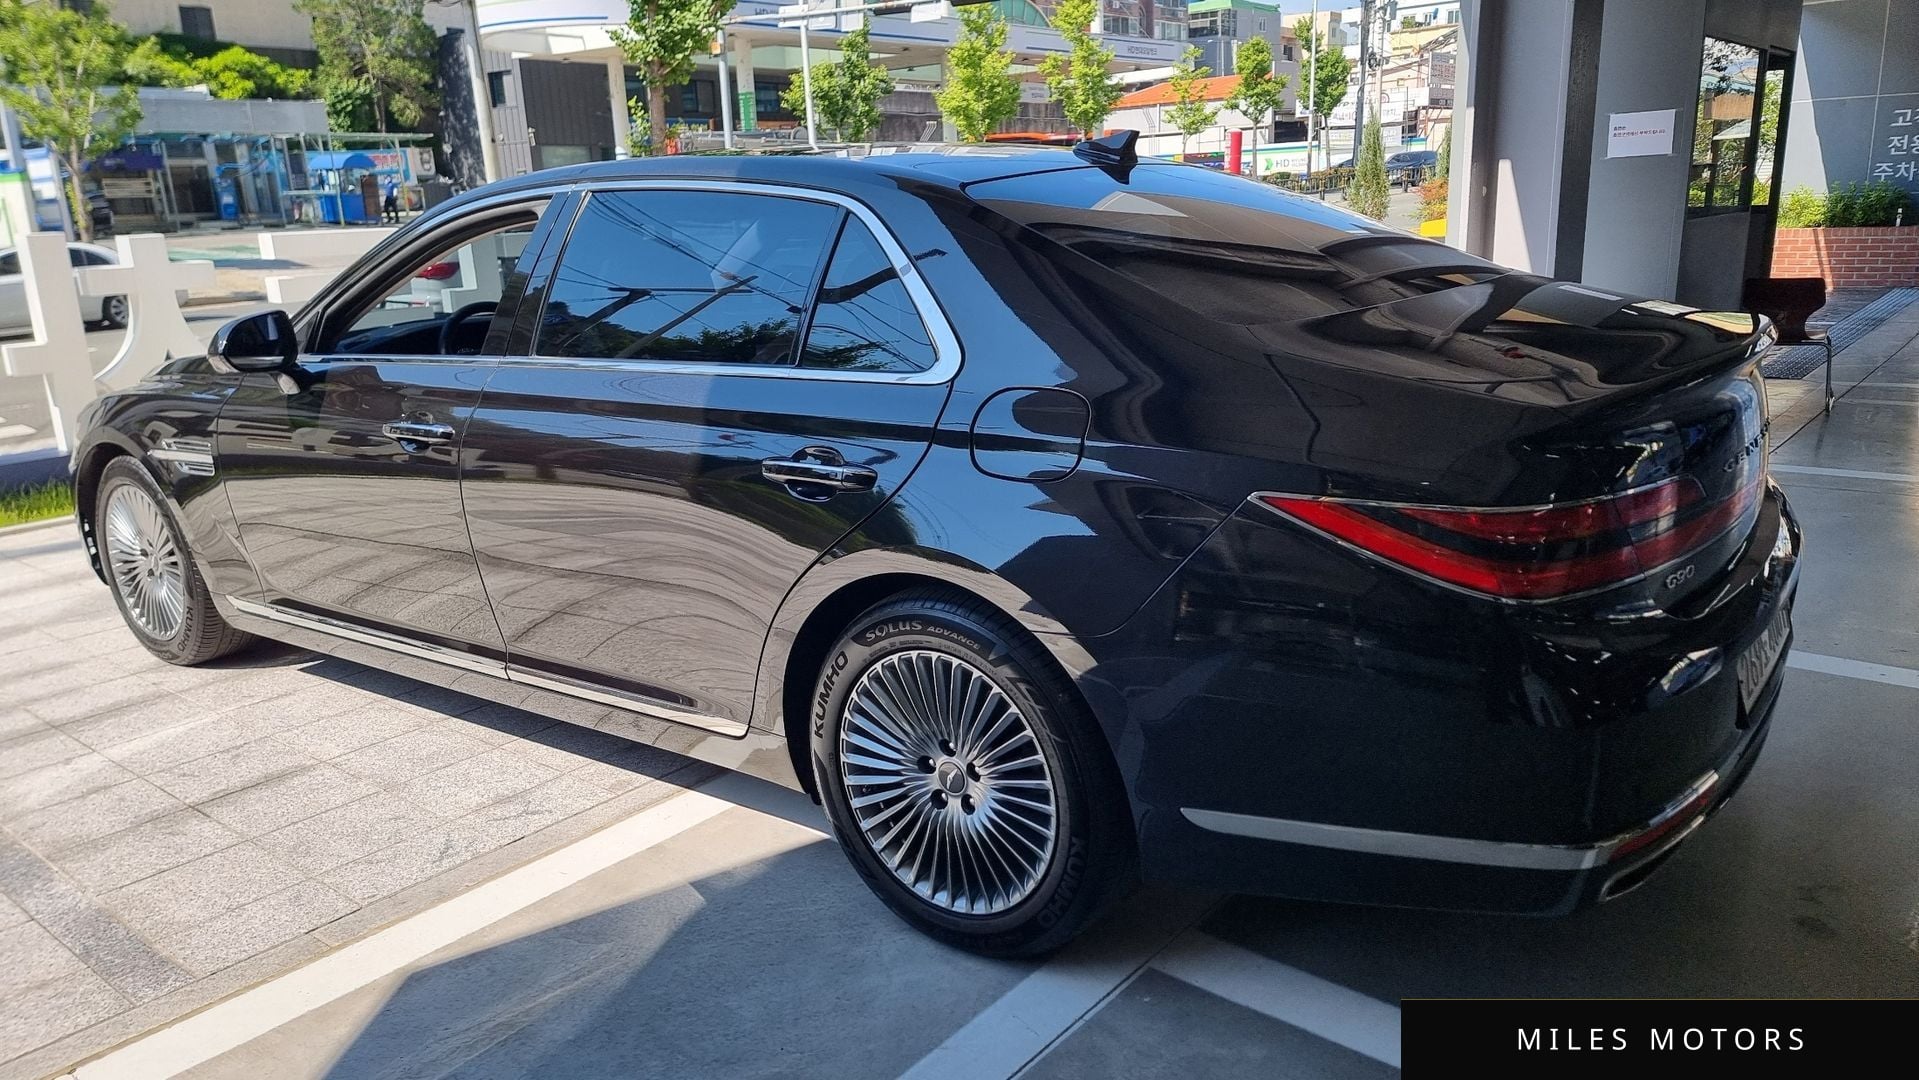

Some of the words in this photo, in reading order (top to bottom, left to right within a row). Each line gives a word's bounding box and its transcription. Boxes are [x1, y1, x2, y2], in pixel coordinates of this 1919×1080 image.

[1889, 109, 1919, 126] 고
[1275, 159, 1290, 168] HD
[1873, 161, 1919, 181] 주차
[1666, 564, 1695, 589] G90
[177, 606, 193, 652] KUMHO
[865, 620, 922, 642] SOLUS
[926, 625, 982, 651] ADVANCE
[814, 650, 848, 739] KUMHO
